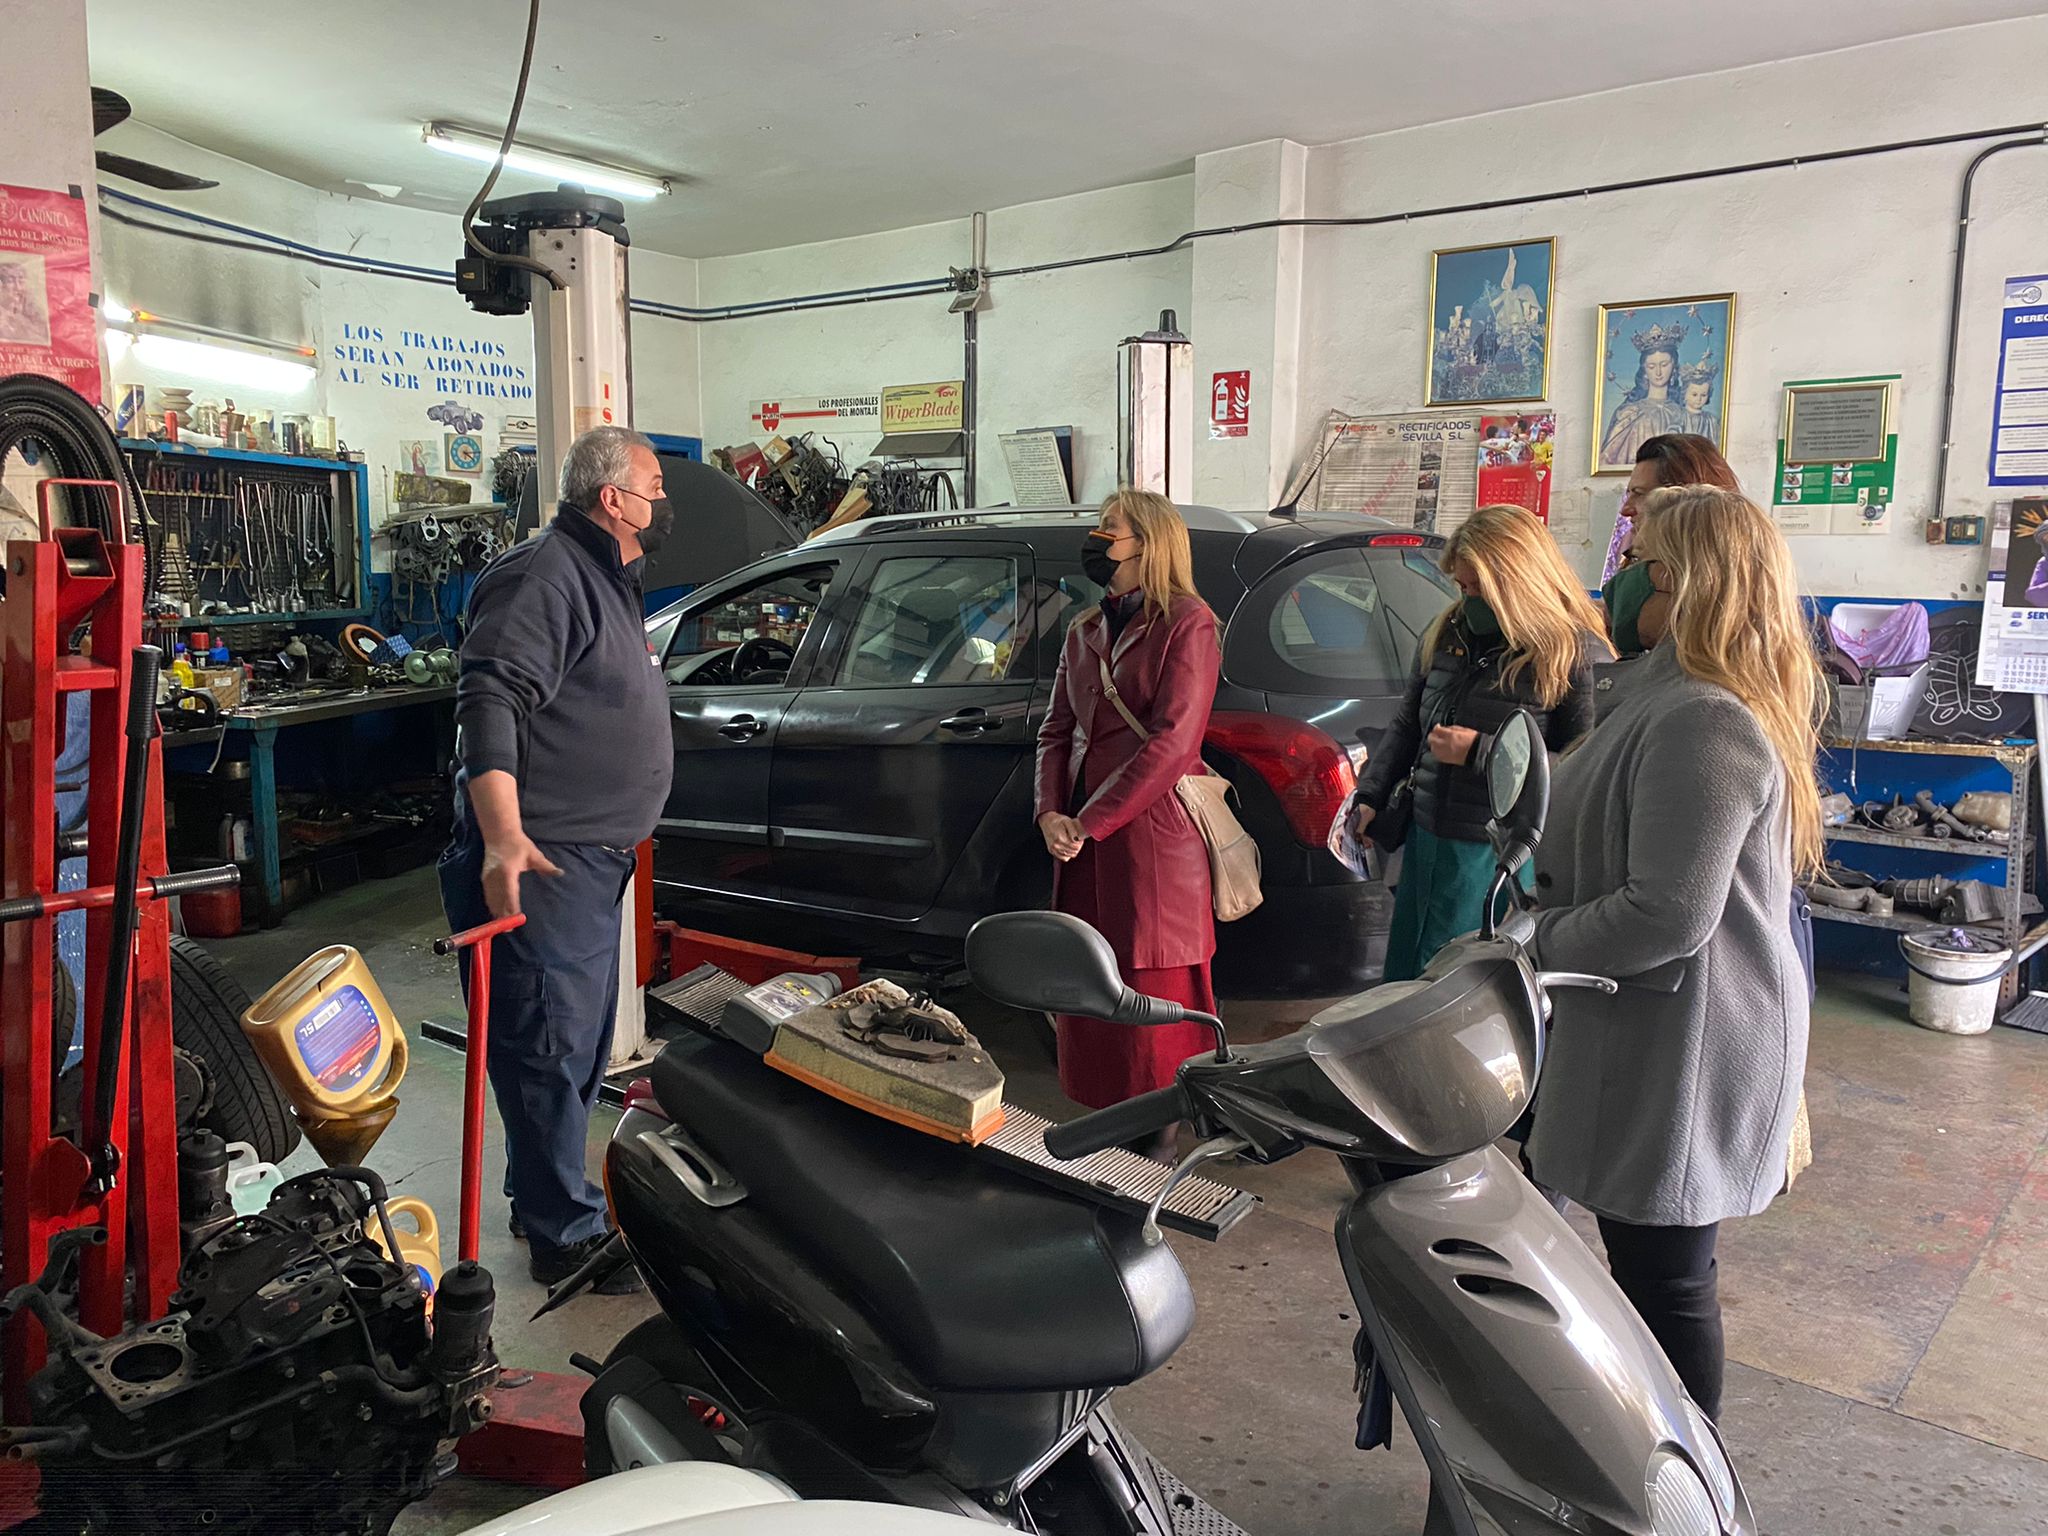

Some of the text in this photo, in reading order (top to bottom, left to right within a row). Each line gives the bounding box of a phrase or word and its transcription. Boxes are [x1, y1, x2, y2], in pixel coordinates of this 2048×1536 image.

[344, 323, 505, 358] LOS TRABAJOS
[55, 356, 94, 369] VIRGEN
[335, 344, 525, 380] SERAN ABONADOS
[336, 367, 532, 399] AL SER RETIRADO
[819, 400, 829, 409] LOS
[831, 397, 879, 408] PROFESIONALES
[838, 406, 878, 417] DEL MONTAJE
[1398, 421, 1472, 432] RECTIFICADOS
